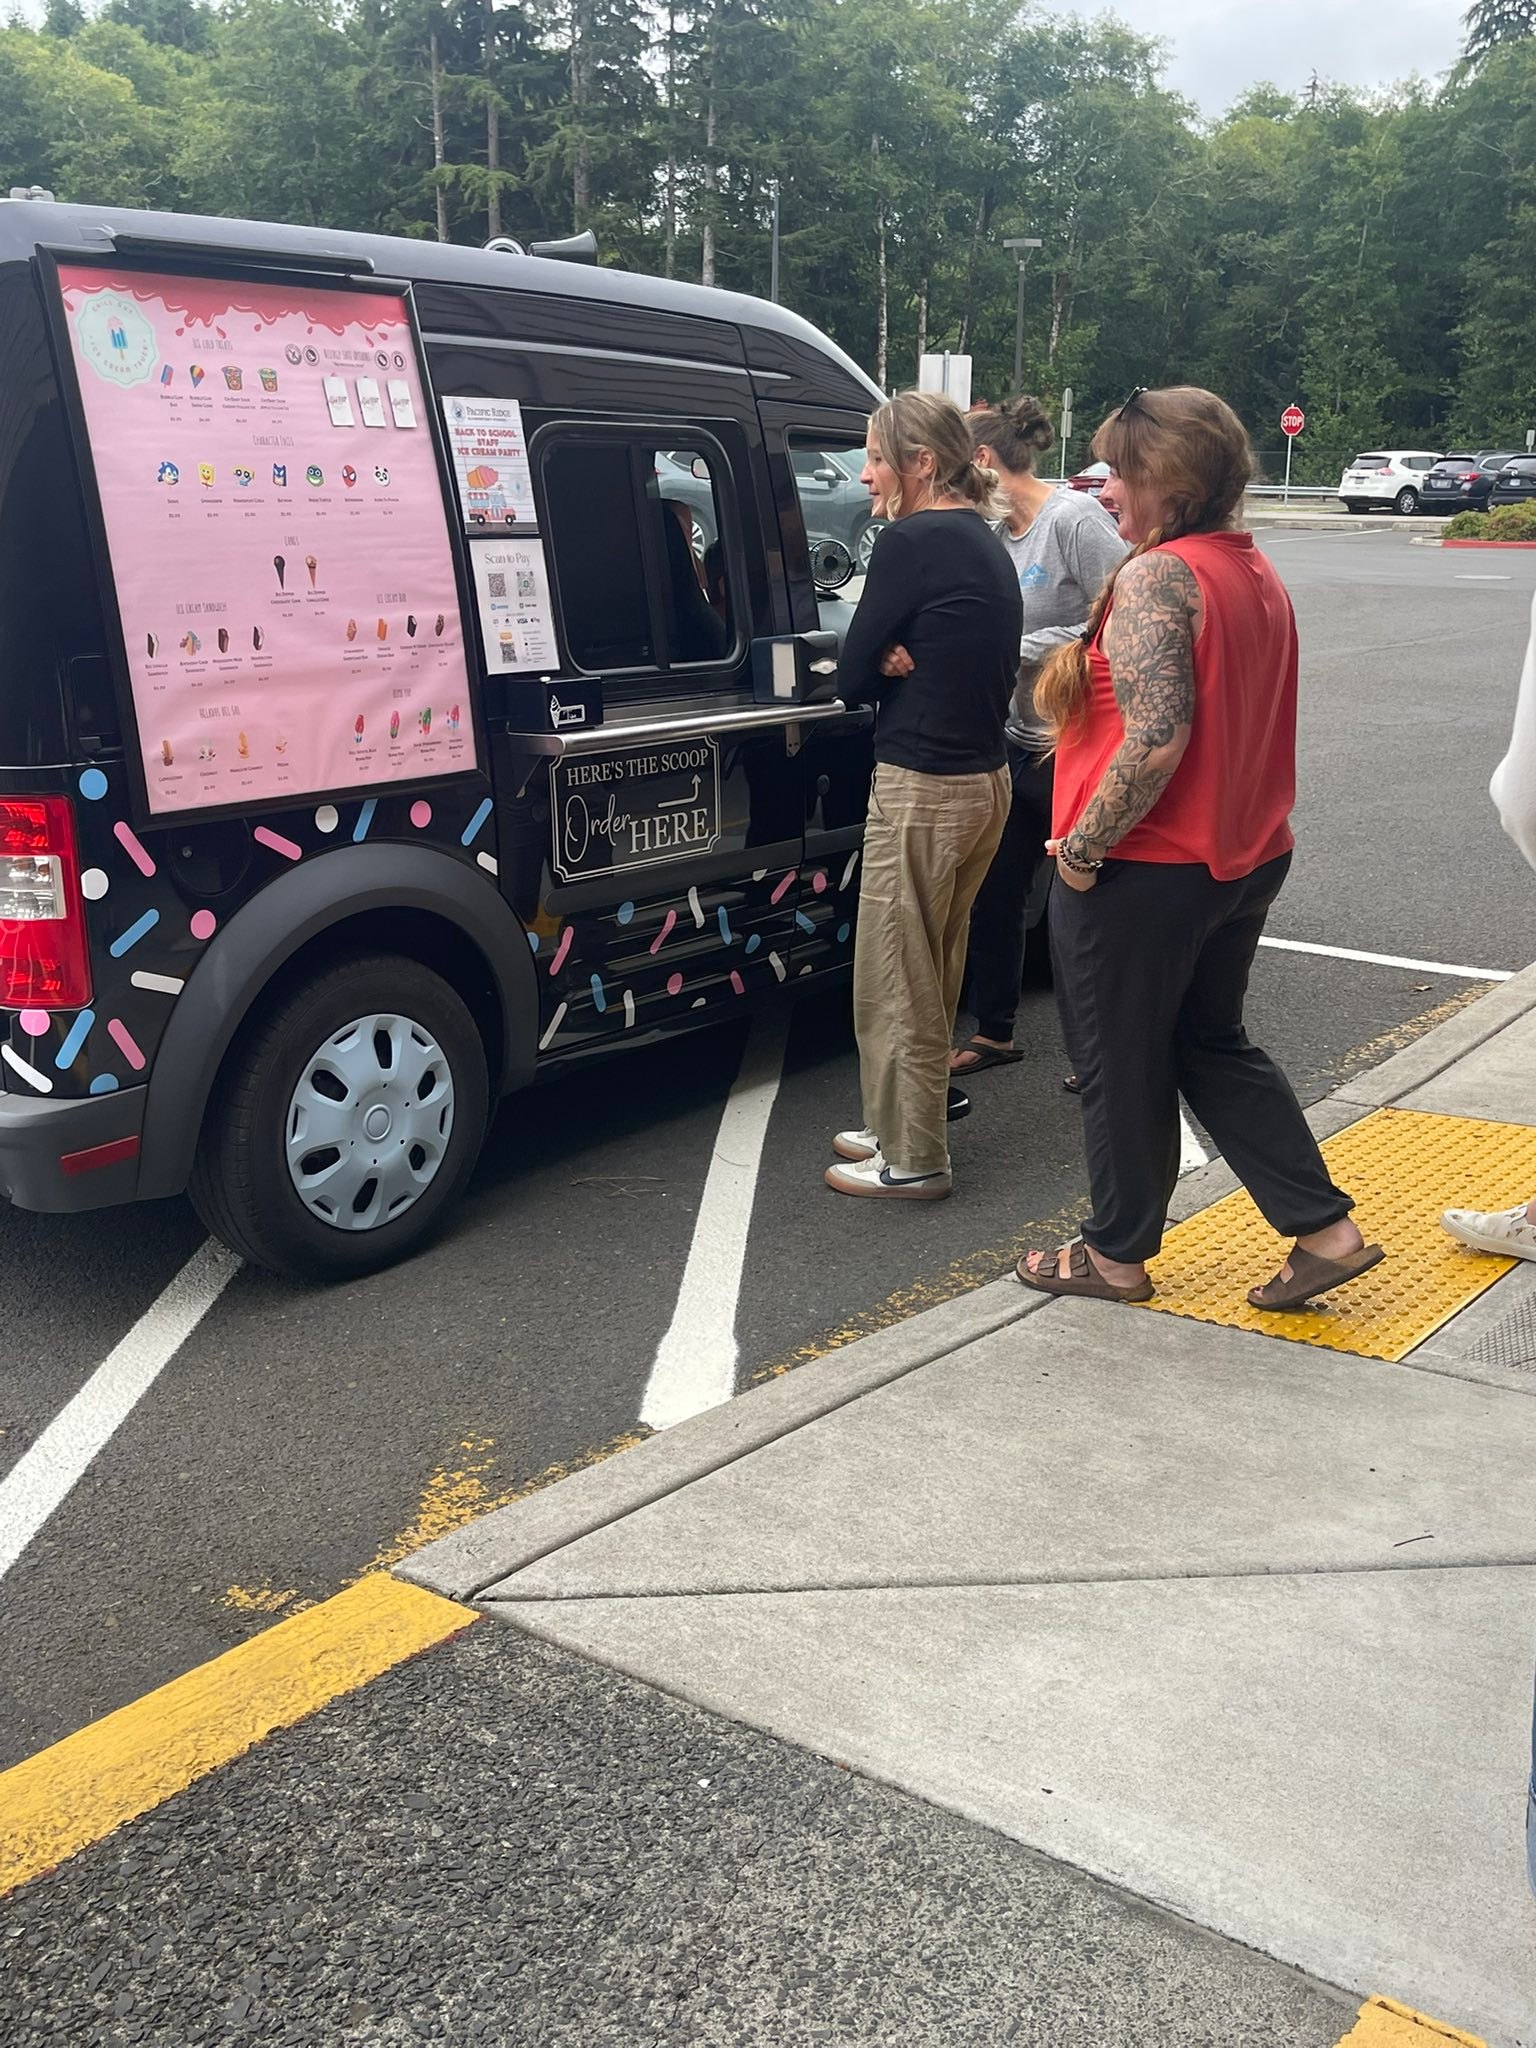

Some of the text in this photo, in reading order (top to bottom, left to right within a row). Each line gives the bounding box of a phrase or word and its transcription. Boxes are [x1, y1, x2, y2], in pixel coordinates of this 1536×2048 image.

[466, 406, 511, 418] PACIFIC RIDGE
[1283, 416, 1302, 427] STOP
[454, 428, 517, 438] BACK TO SCHOOL
[252, 434, 279, 446] CHARACTER
[477, 439, 499, 447] STAFF
[457, 447, 520, 457] ICE CREAM PARTY
[484, 552, 530, 566] Scan to Pay
[186, 602, 201, 614] CREAM
[202, 602, 227, 612] SANDWICH
[566, 748, 709, 786] HERE'S THE SCOOP
[564, 794, 710, 863] Order HERE
